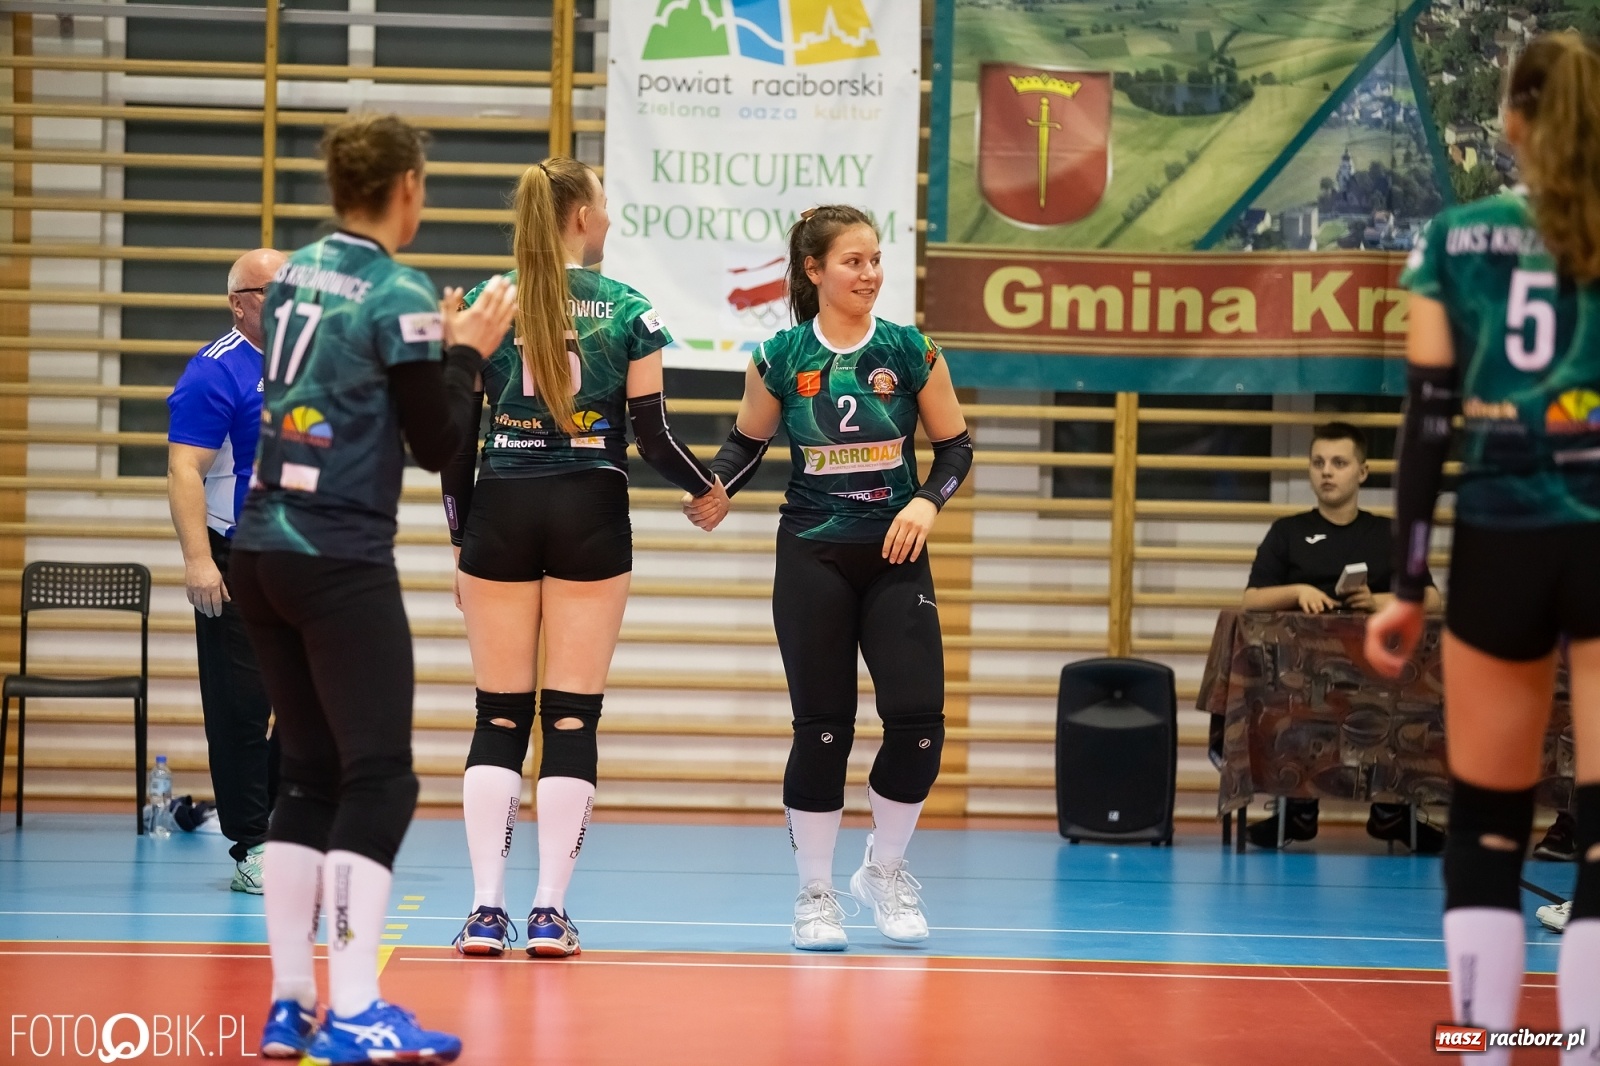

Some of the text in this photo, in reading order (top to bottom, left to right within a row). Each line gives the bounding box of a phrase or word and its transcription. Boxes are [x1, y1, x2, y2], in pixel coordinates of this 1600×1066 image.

[637, 71, 884, 97] powiat raciborski
[637, 101, 720, 118] zielona
[814, 103, 881, 121] kultur
[651, 149, 873, 195] KIBICUJEMY
[620, 202, 898, 244] SPORTOWM
[566, 299, 615, 319] OWICE
[982, 265, 1410, 334] Gmina Krz
[1505, 268, 1557, 373] 5
[268, 298, 324, 386] 17
[837, 394, 860, 433] 2
